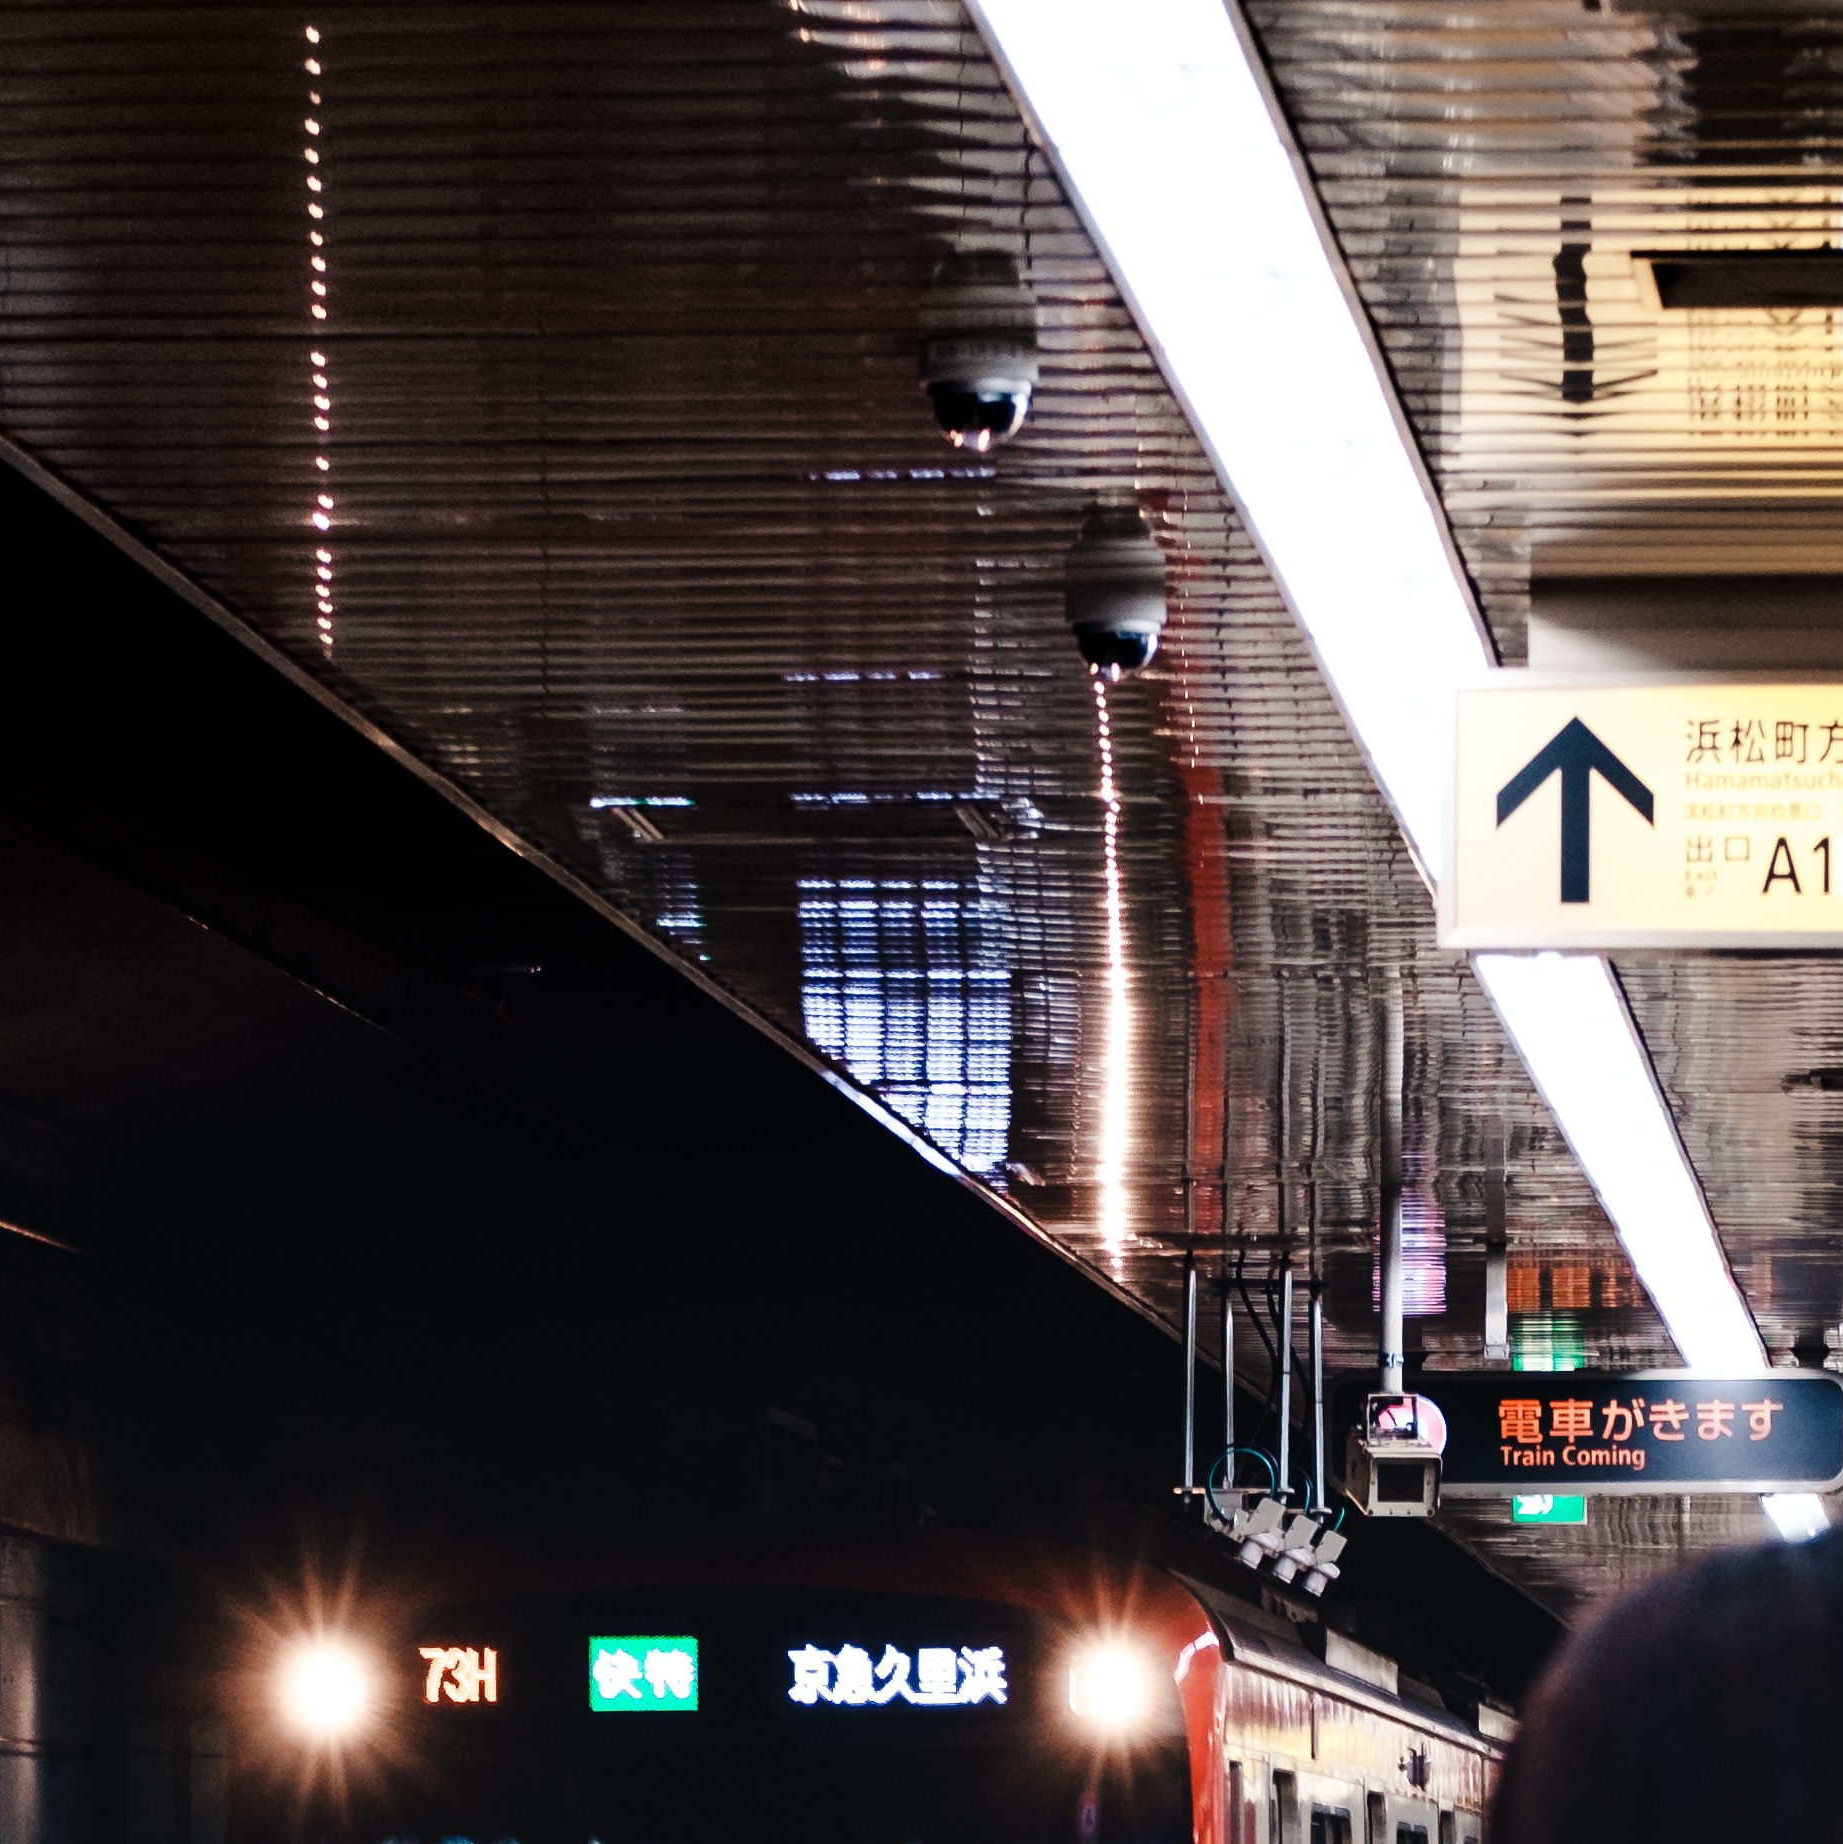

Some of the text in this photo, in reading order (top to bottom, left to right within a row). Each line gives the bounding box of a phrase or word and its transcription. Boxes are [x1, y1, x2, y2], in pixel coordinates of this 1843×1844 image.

[1686, 835, 1750, 863] 出口
[1762, 836, 1830, 895] A1
[1497, 1398, 1783, 1444] 電車がきます
[1500, 1445, 1646, 1471] Train Coming
[418, 1646, 498, 1704] 73H
[787, 1643, 1008, 1705] 京急久里浜
